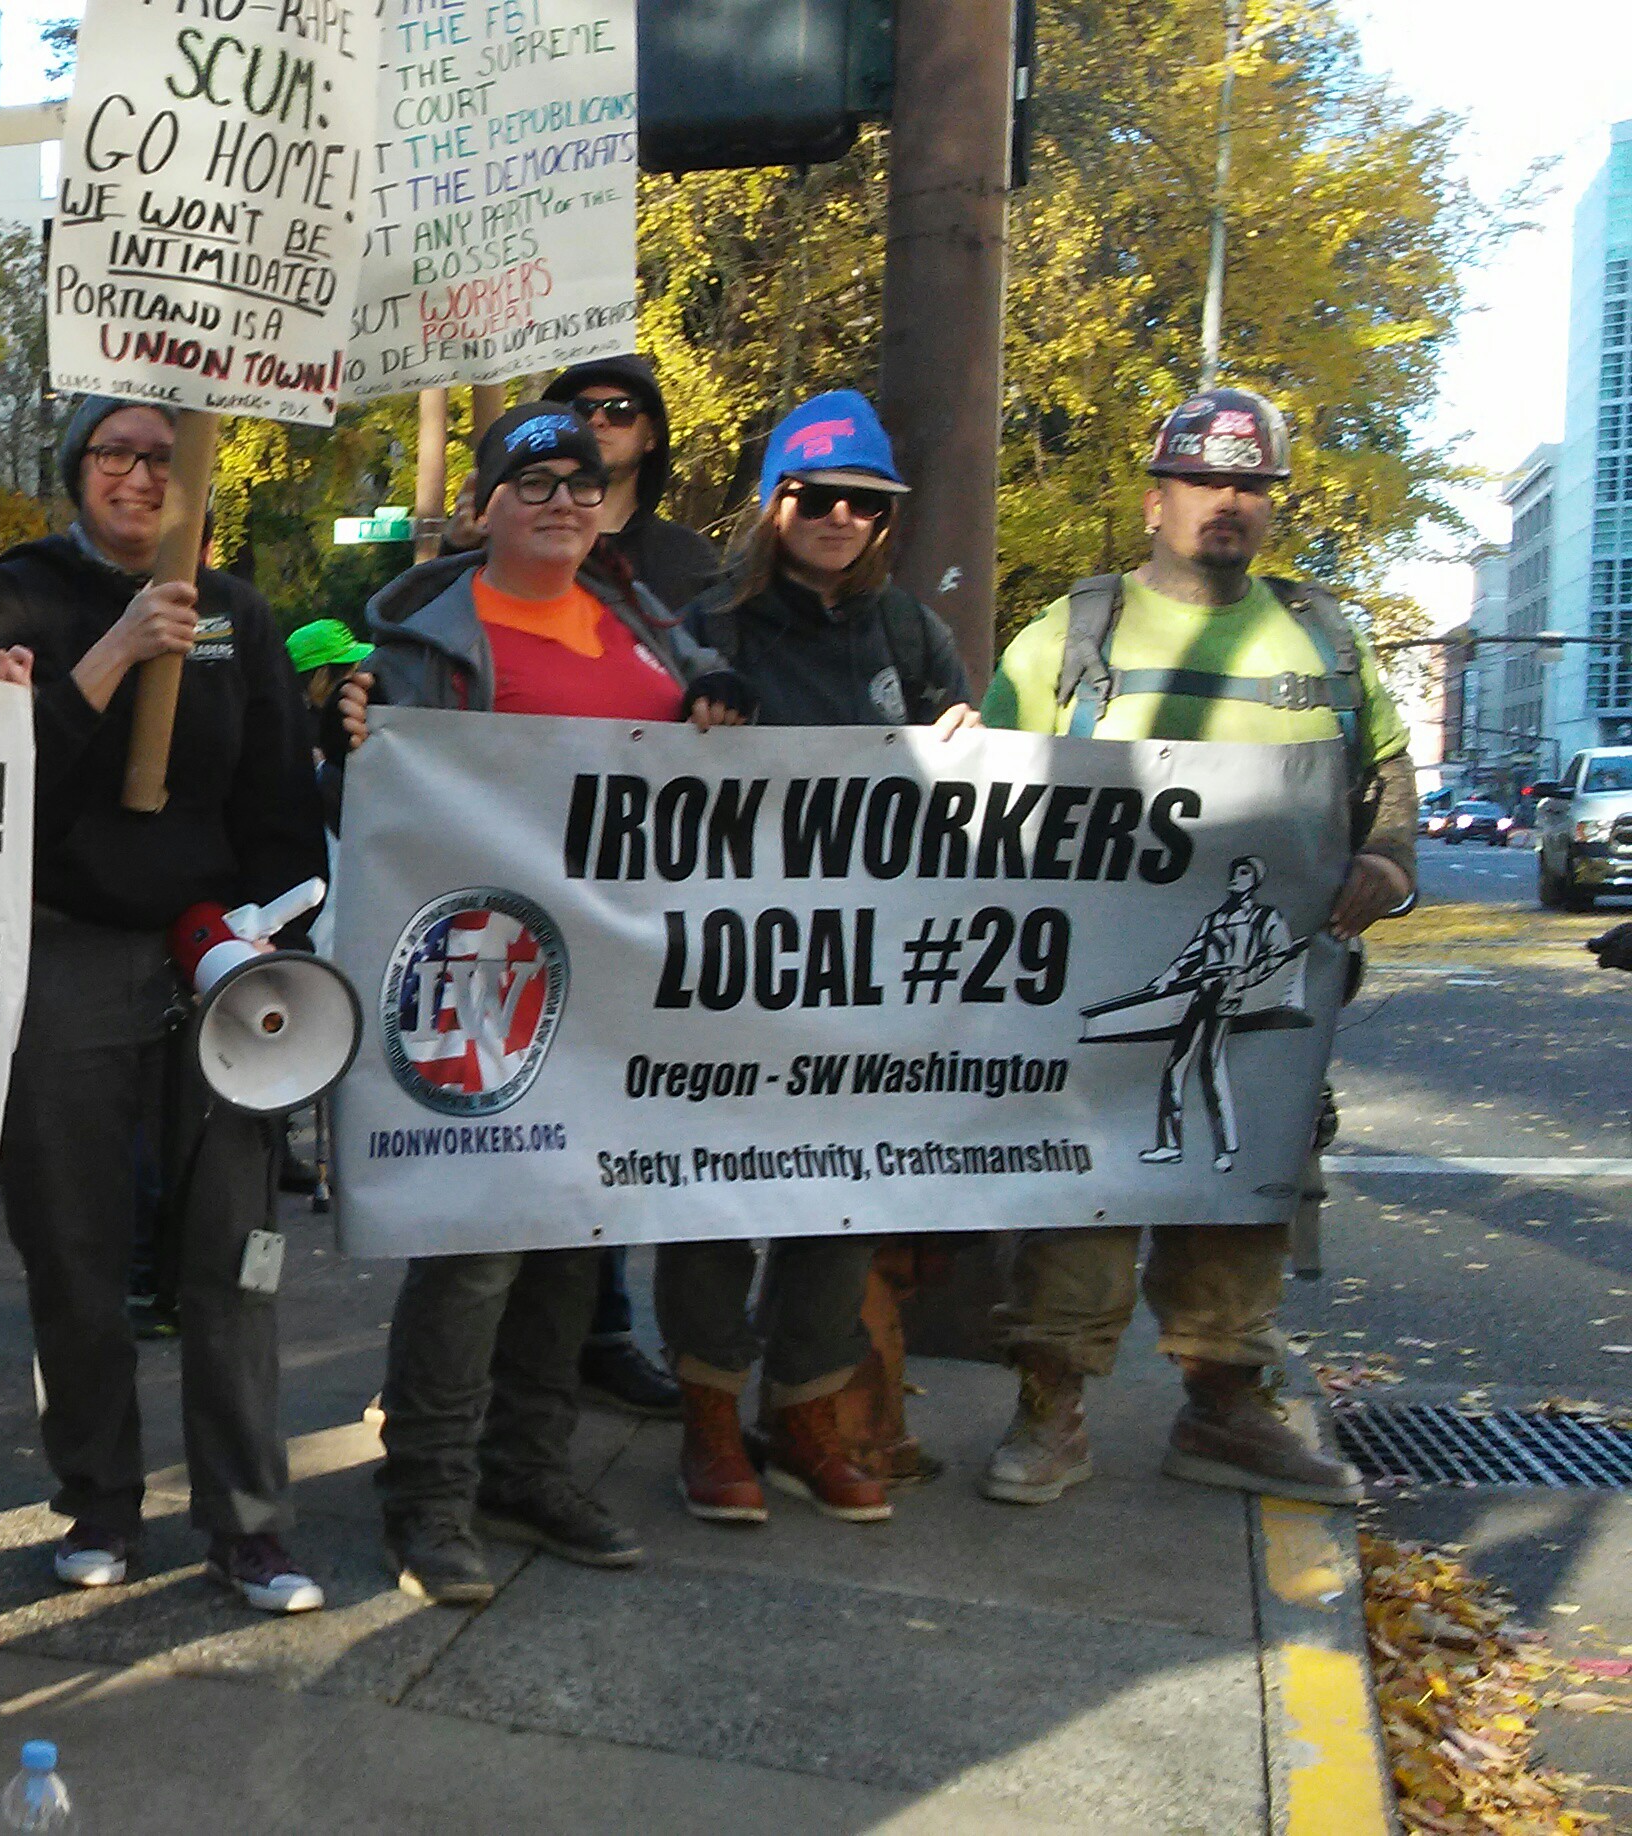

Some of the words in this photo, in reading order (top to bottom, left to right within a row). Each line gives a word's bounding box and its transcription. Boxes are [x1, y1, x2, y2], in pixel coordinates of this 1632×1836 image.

[395, 56, 460, 91] THE
[476, 19, 616, 77] SUPREME
[398, 12, 470, 52] THE
[485, 0, 540, 39] FBI
[165, 27, 332, 131] SCUM:
[393, 80, 496, 130] COURT
[85, 94, 178, 174] GO
[205, 120, 360, 223] HOME!
[403, 125, 479, 169] THE
[407, 169, 475, 211] THE
[485, 132, 637, 196] DEMOCRATS
[61, 178, 125, 218] WE
[139, 191, 264, 244] WON'T
[285, 218, 332, 258] BE
[414, 211, 471, 253] ANY
[482, 186, 554, 239] PARTY
[582, 188, 622, 208] THE
[109, 230, 337, 306] INTIMIDATED
[413, 228, 539, 285] BOSSES
[419, 257, 552, 322] WORKERS
[55, 264, 220, 331] PORTLAND
[100, 323, 235, 381] UNION
[244, 350, 344, 413] TOWN!
[381, 338, 498, 375] DEFEND
[563, 774, 771, 882] IRON
[783, 777, 1202, 884] WORKERS
[654, 907, 882, 1011] LOCAL
[902, 907, 1070, 1006] #29
[625, 1053, 759, 1103] Oregon
[787, 1055, 847, 1097] SW
[852, 1053, 1070, 1098] Washington
[368, 1122, 567, 1158] IRONWORKERS.ORG
[597, 1149, 687, 1187] Safety,
[692, 1145, 871, 1183] Productivity,
[875, 1137, 1092, 1178] Craftsmanship
